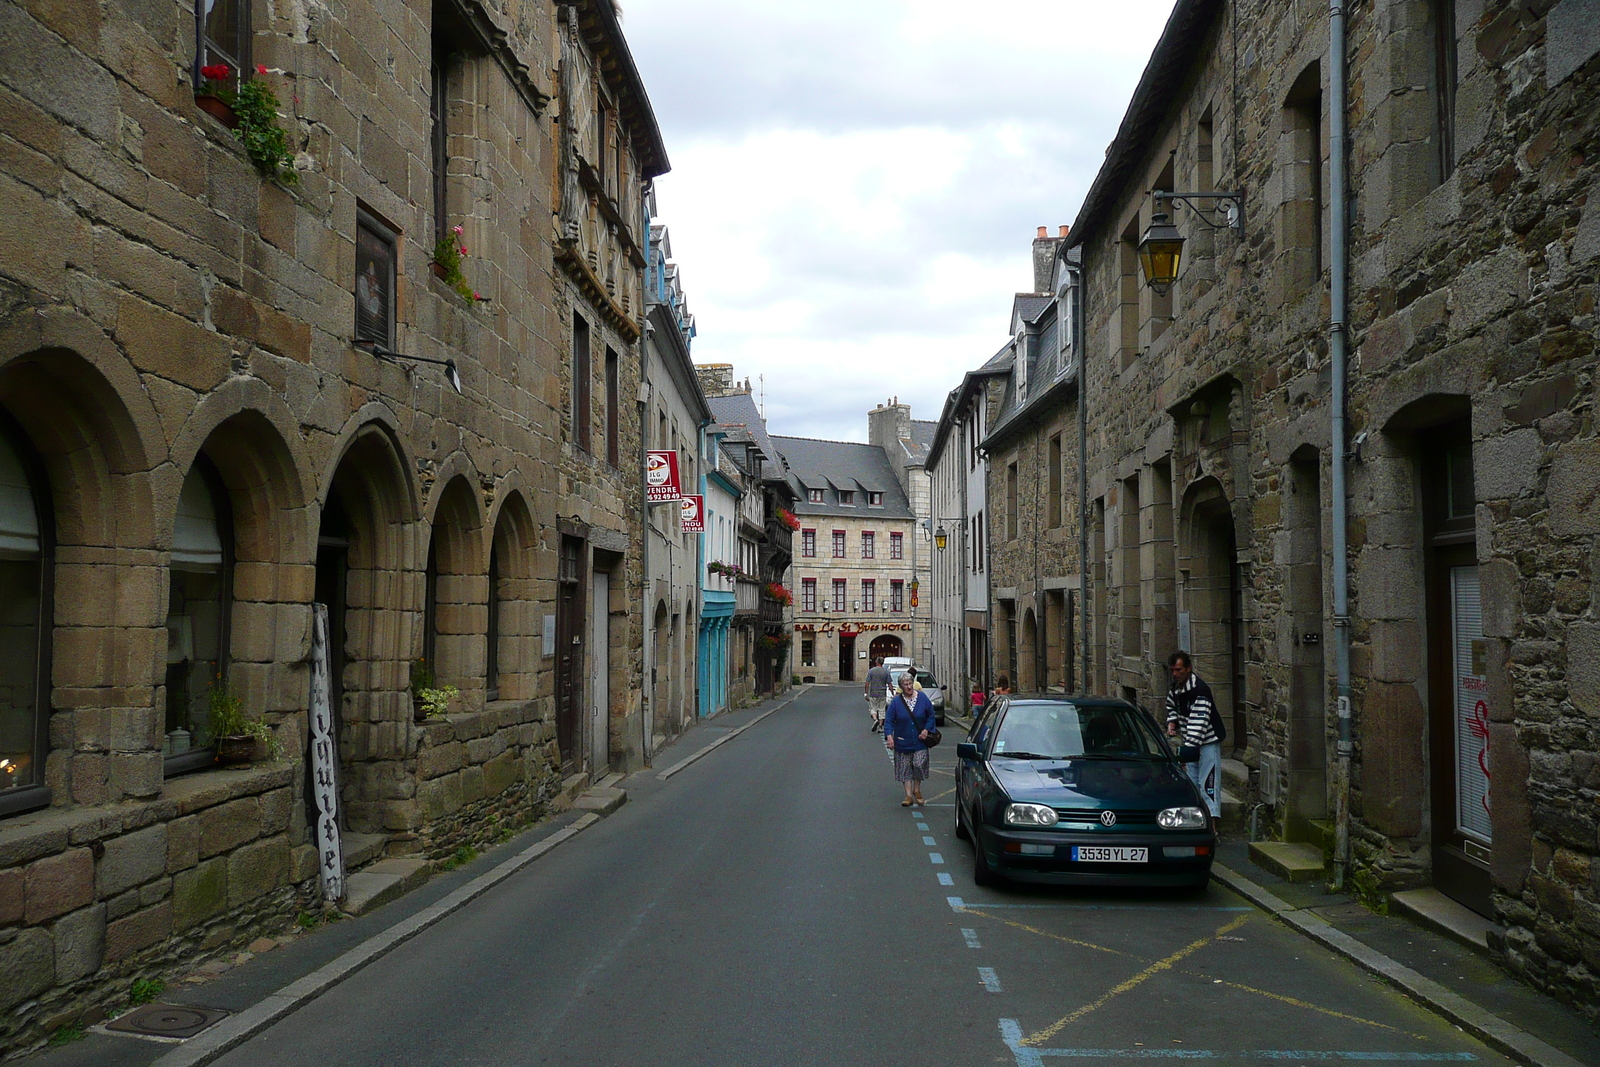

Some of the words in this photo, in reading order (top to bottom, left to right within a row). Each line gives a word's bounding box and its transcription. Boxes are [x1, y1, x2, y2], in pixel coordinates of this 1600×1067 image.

[818, 622, 835, 633] Le
[838, 622, 852, 632] St
[881, 623, 912, 631] HOTEL
[1080, 848, 1111, 860] 3539
[1113, 848, 1128, 861] YL
[1130, 849, 1146, 861] 27
